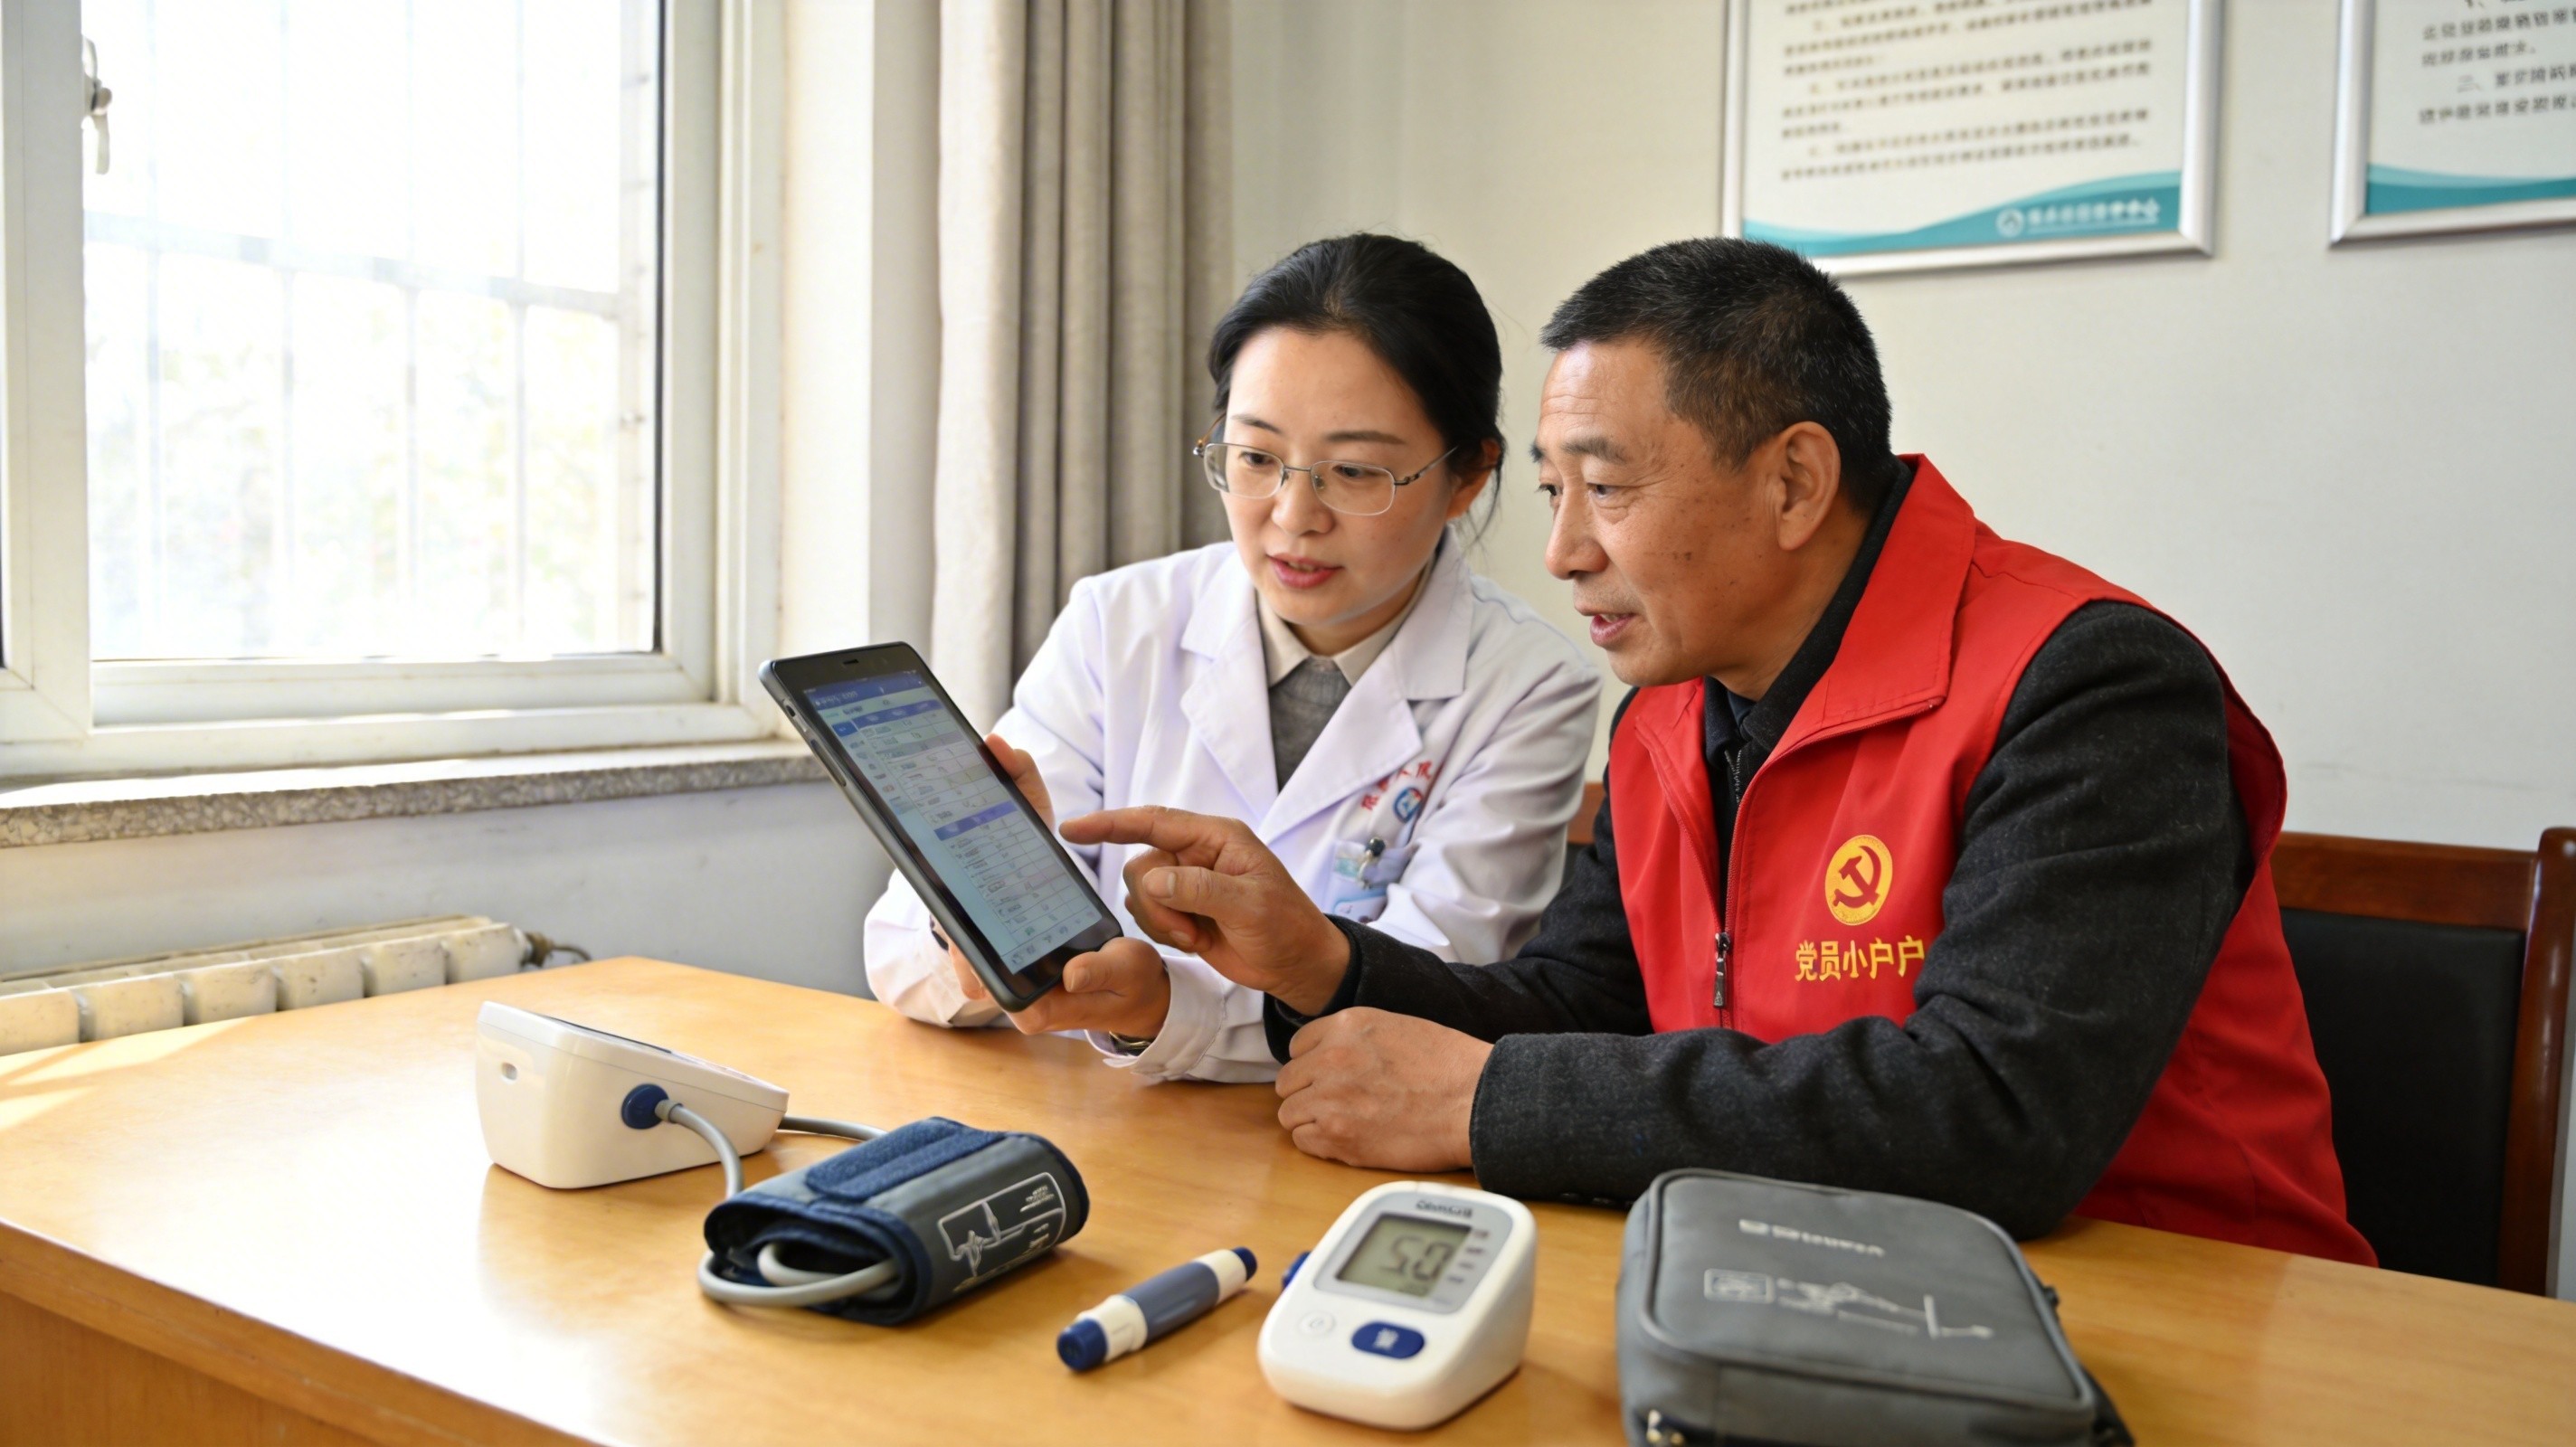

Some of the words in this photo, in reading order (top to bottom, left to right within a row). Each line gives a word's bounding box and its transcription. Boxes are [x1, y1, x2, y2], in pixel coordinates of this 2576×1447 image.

[1795, 935, 1925, 981] 党员小户户
